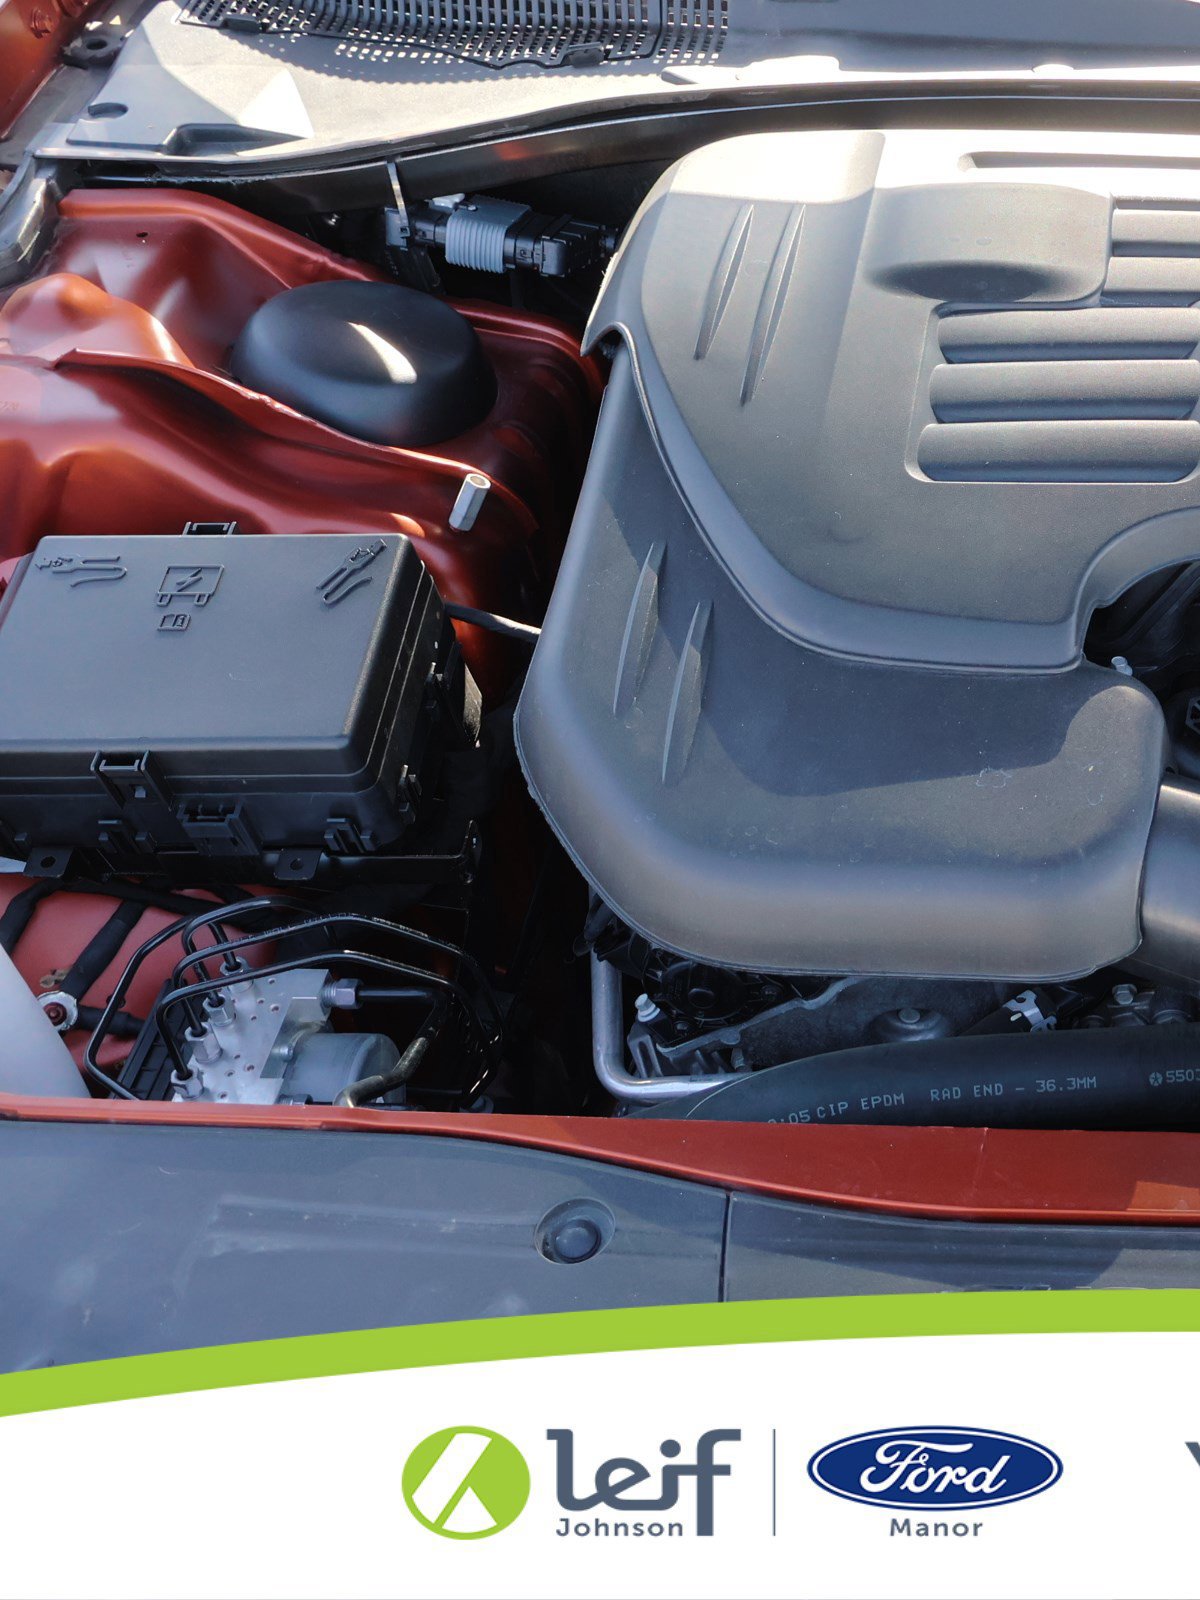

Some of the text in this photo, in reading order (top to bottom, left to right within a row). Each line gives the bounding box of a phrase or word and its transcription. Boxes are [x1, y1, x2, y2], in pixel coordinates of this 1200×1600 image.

[816, 1101, 849, 1119] CIP
[860, 1092, 905, 1111] EPDM
[930, 1088, 962, 1102] RAD
[973, 1082, 1004, 1099] END
[1035, 1075, 1097, 1095] 36.3MM
